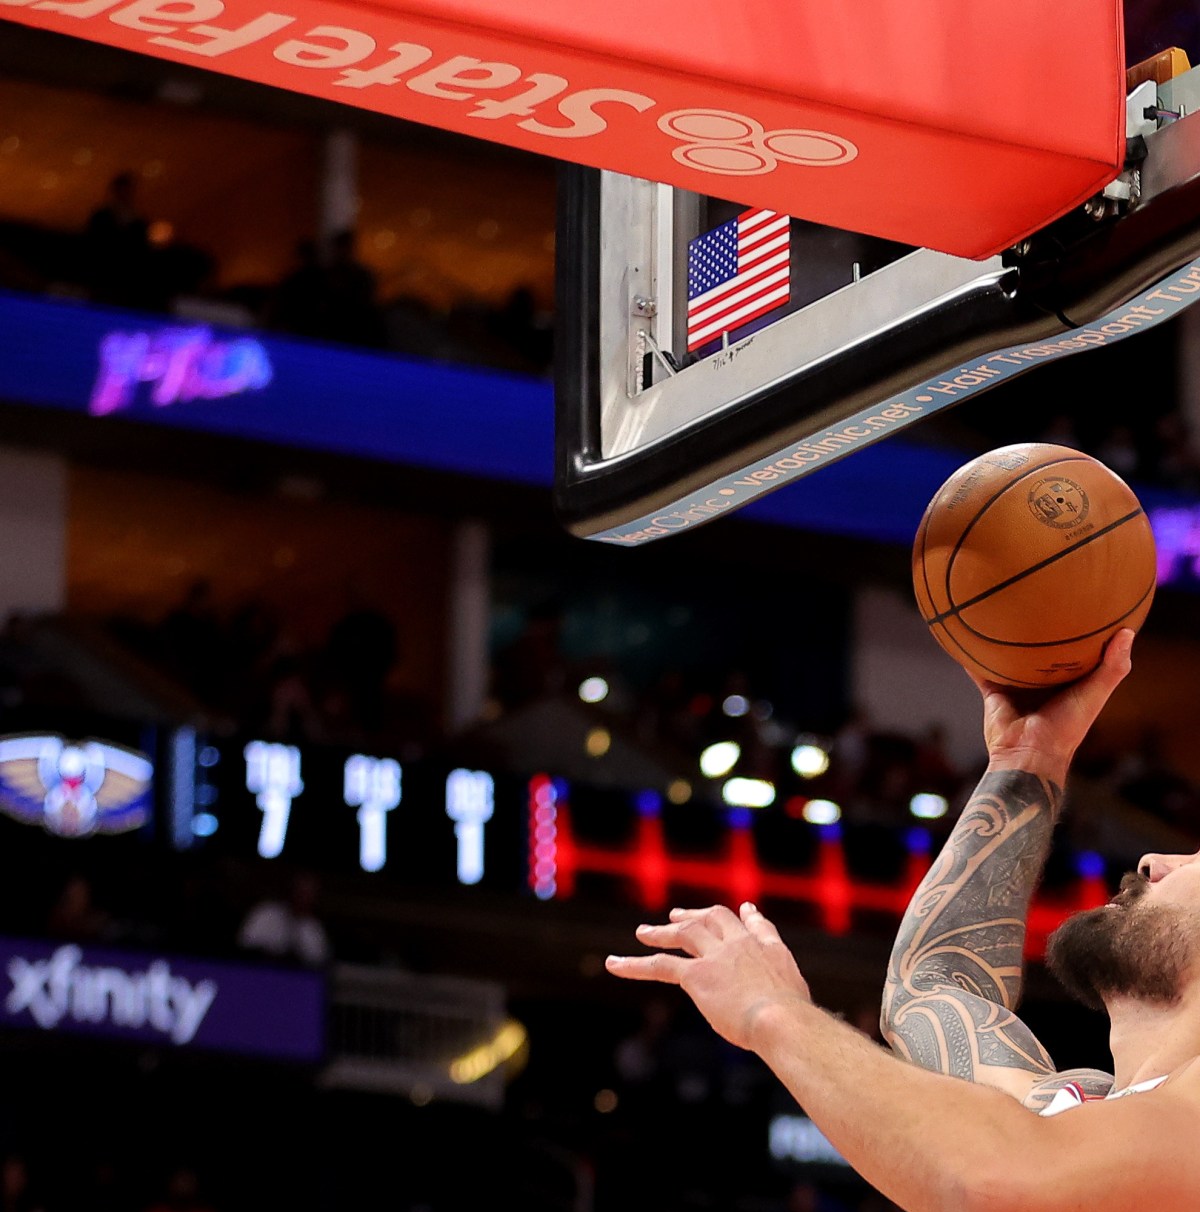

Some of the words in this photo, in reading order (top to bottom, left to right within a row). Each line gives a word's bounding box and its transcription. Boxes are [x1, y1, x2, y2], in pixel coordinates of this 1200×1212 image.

[733, 402, 923, 487] veraclinic.net
[927, 362, 1003, 396] Hair
[994, 303, 1165, 366] Transplant
[8, 945, 217, 1045] xfinity
